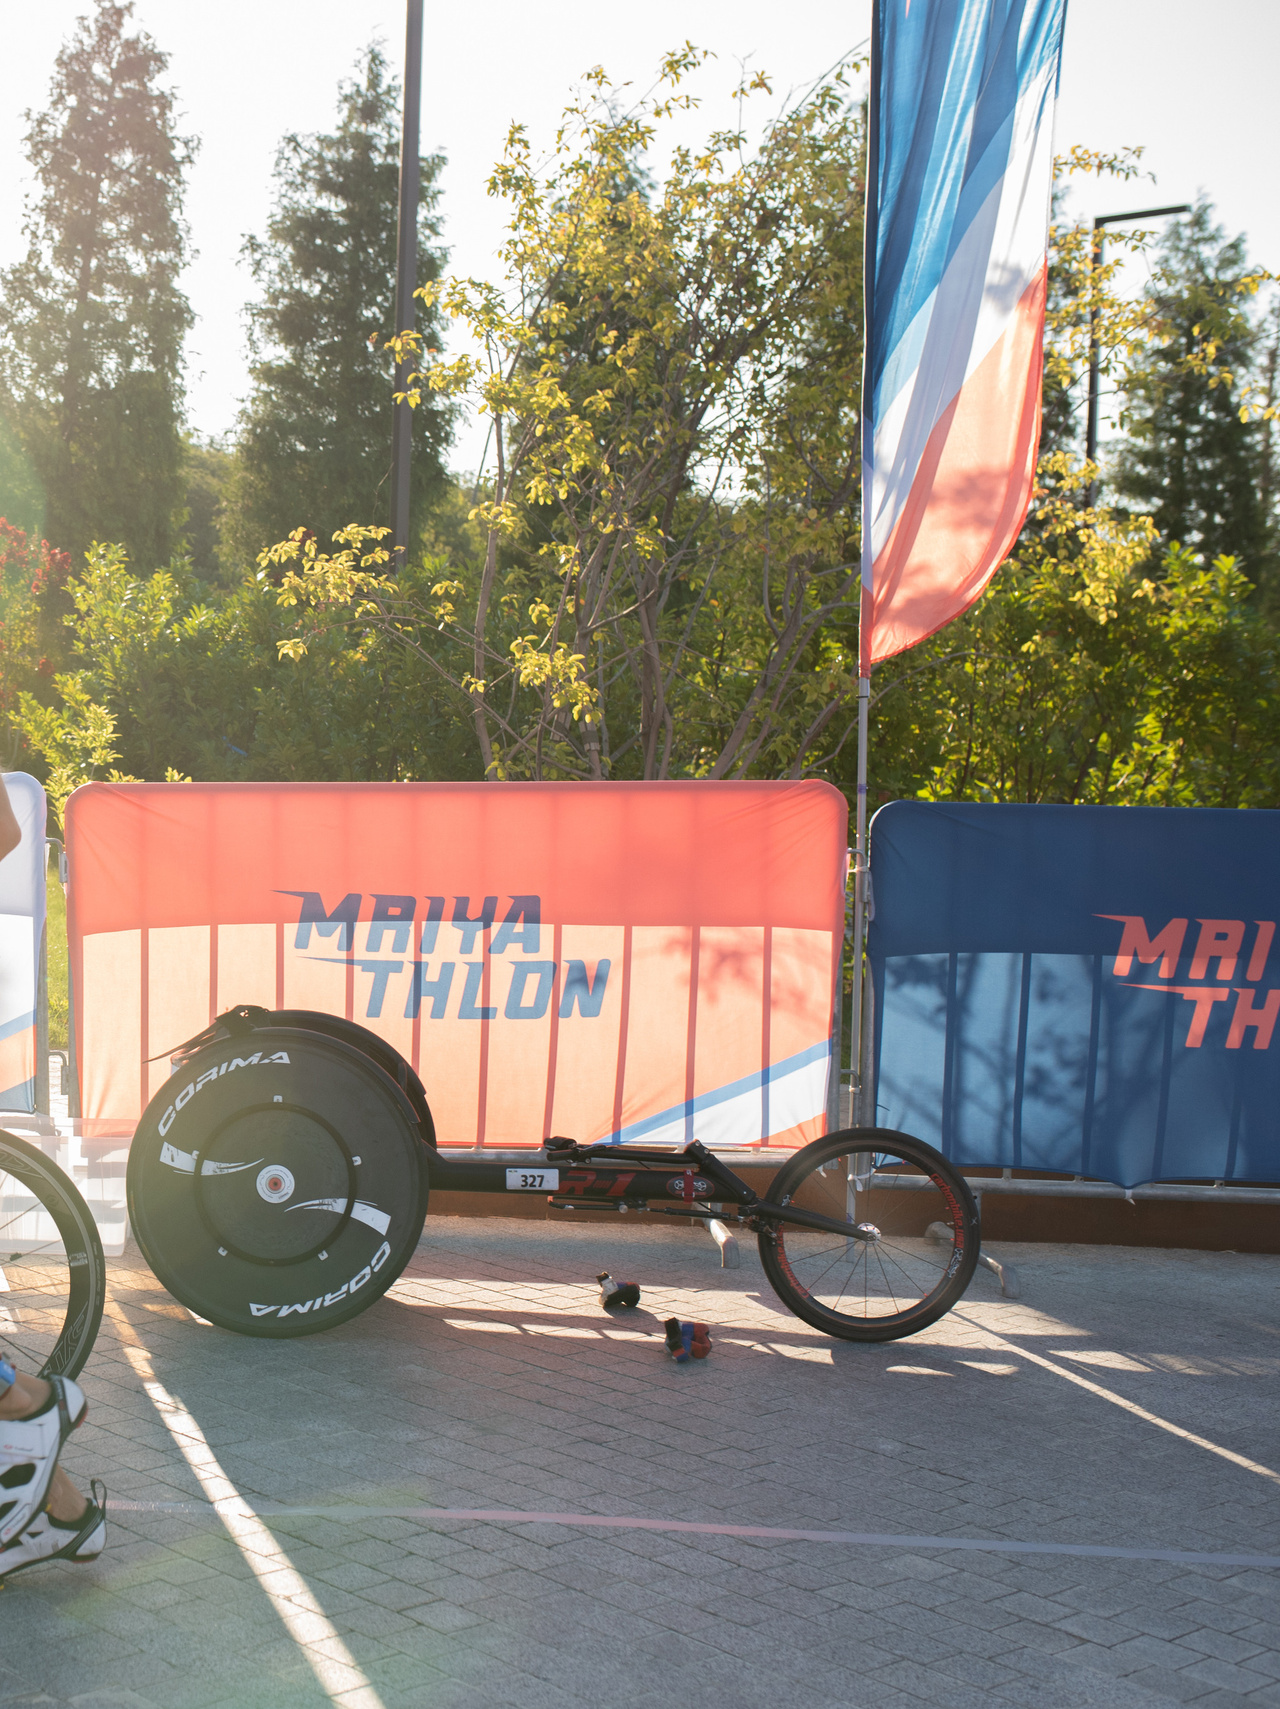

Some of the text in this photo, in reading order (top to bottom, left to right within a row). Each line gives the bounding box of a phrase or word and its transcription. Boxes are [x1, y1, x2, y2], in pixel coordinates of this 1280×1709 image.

[270, 890, 541, 955] MRIYA
[296, 956, 612, 1020] THLON
[158, 1052, 291, 1137] CORIMA
[520, 1175, 544, 1187] 327
[249, 1241, 392, 1318] CORIMA
